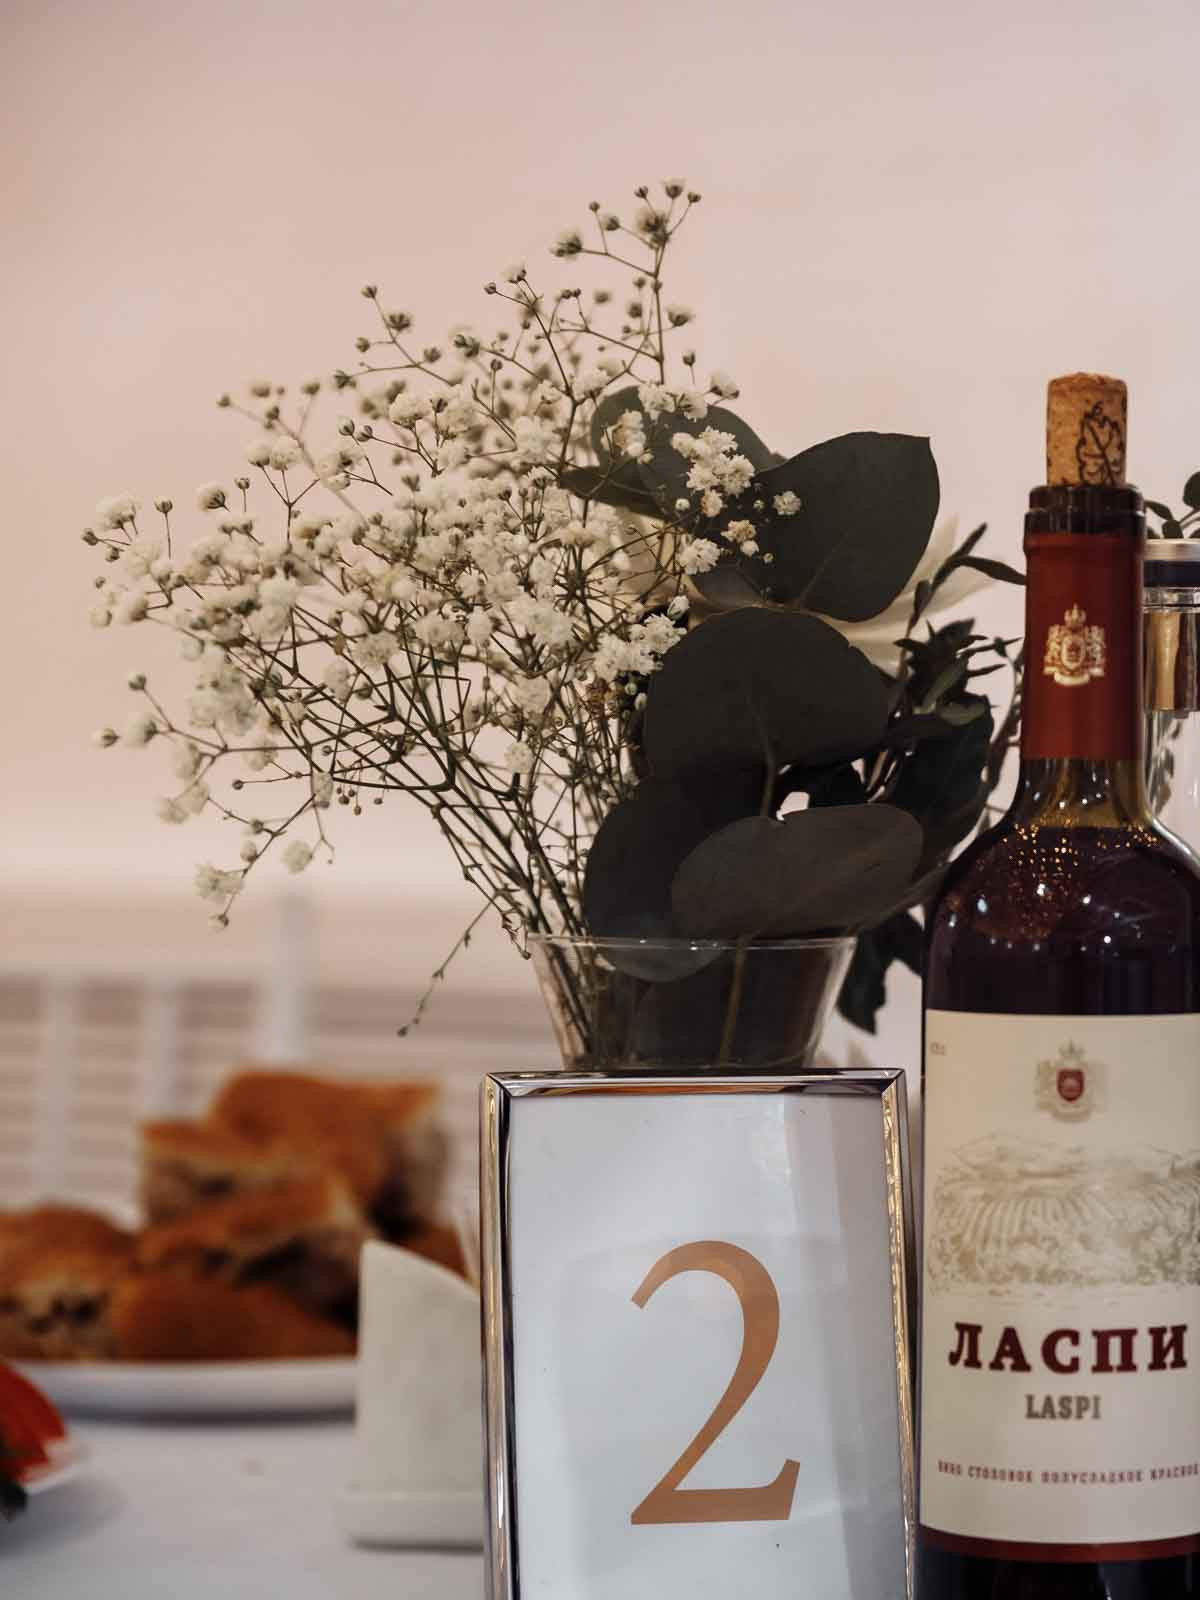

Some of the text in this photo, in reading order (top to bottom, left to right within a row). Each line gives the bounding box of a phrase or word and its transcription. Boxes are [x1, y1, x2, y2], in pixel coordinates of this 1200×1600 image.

[948, 1322, 1187, 1374] ЛАСПИ
[631, 1240, 800, 1525] 2
[1025, 1394, 1101, 1420] LASPI
